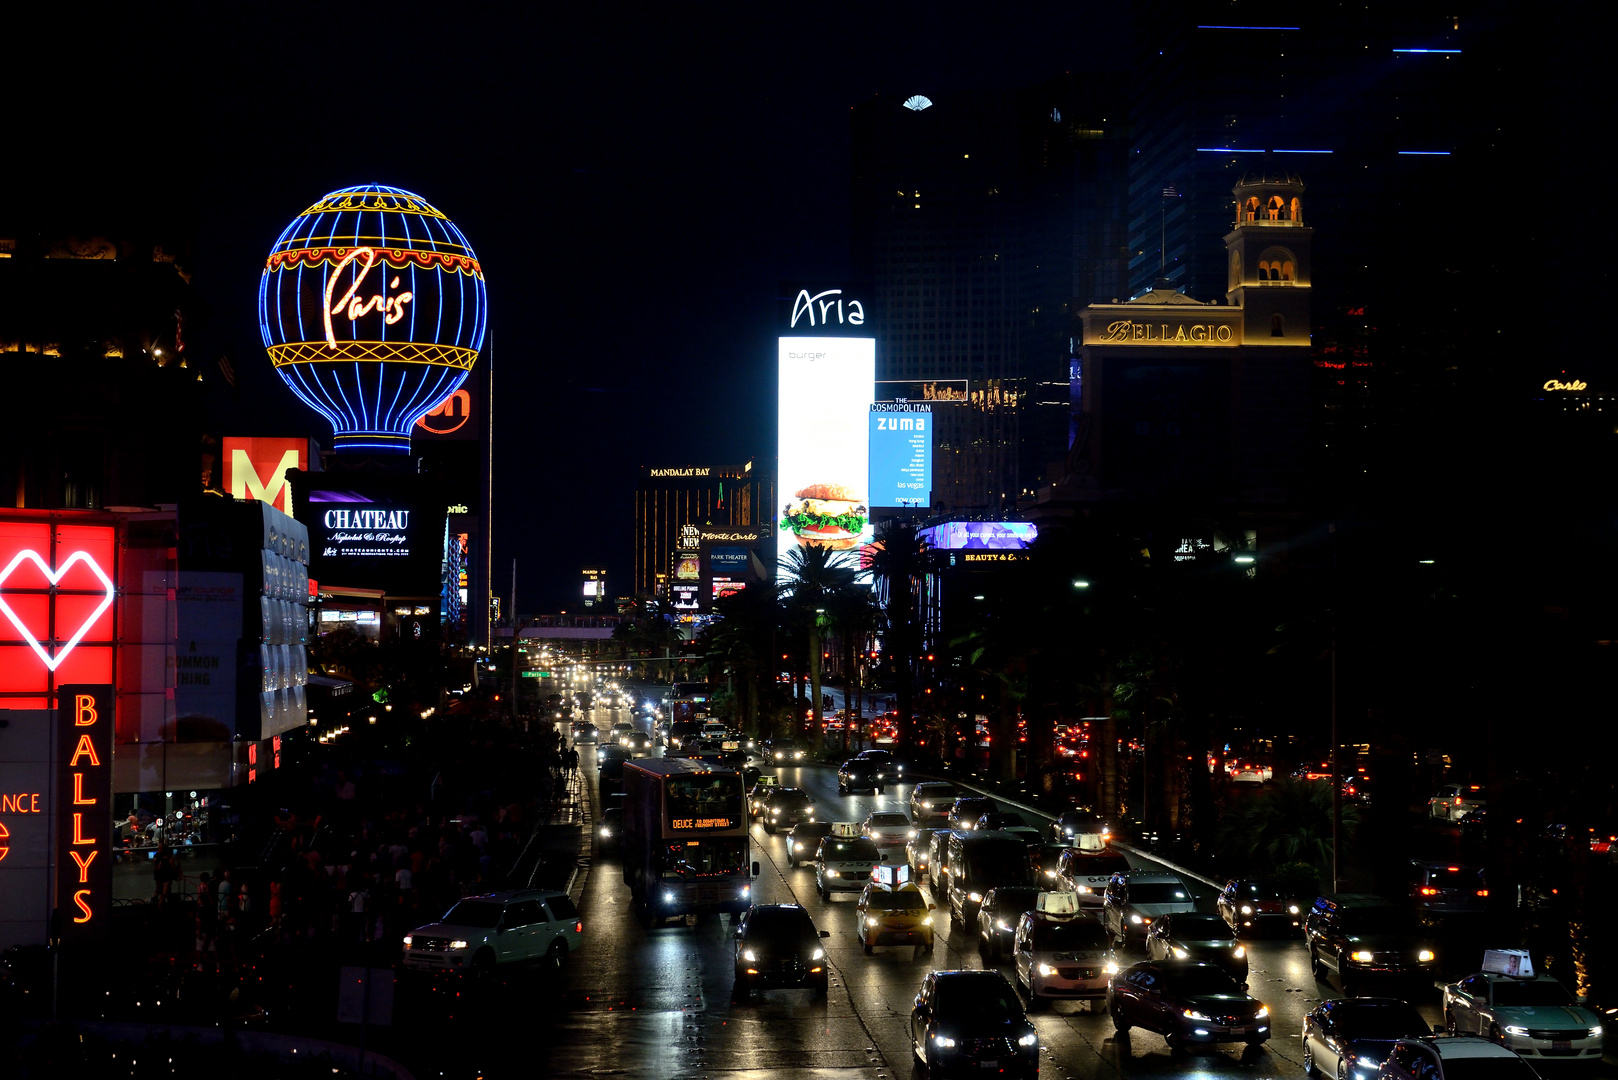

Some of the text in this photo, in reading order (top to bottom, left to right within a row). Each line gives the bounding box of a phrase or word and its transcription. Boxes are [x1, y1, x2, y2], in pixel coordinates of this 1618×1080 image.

[324, 246, 413, 350] Paris
[790, 289, 865, 328] Aria
[1099, 320, 1233, 342] BELLAGIO
[788, 352, 826, 361] burger
[1543, 379, 1587, 391] Carlo
[871, 403, 931, 412] COSMOPOLITAN
[877, 418, 925, 430] zuma
[651, 468, 710, 476] MANDALAY BAY
[232, 449, 299, 518] M
[324, 510, 410, 529] CHATEAU
[683, 527, 699, 535] NEW
[731, 533, 757, 541] Carlo
[327, 532, 406, 544] Nightclub & Rooftop
[683, 538, 699, 547] NEW
[0, 793, 41, 813] NCE
[69, 694, 101, 923] BALLYS
[672, 819, 693, 829] DEUCE
